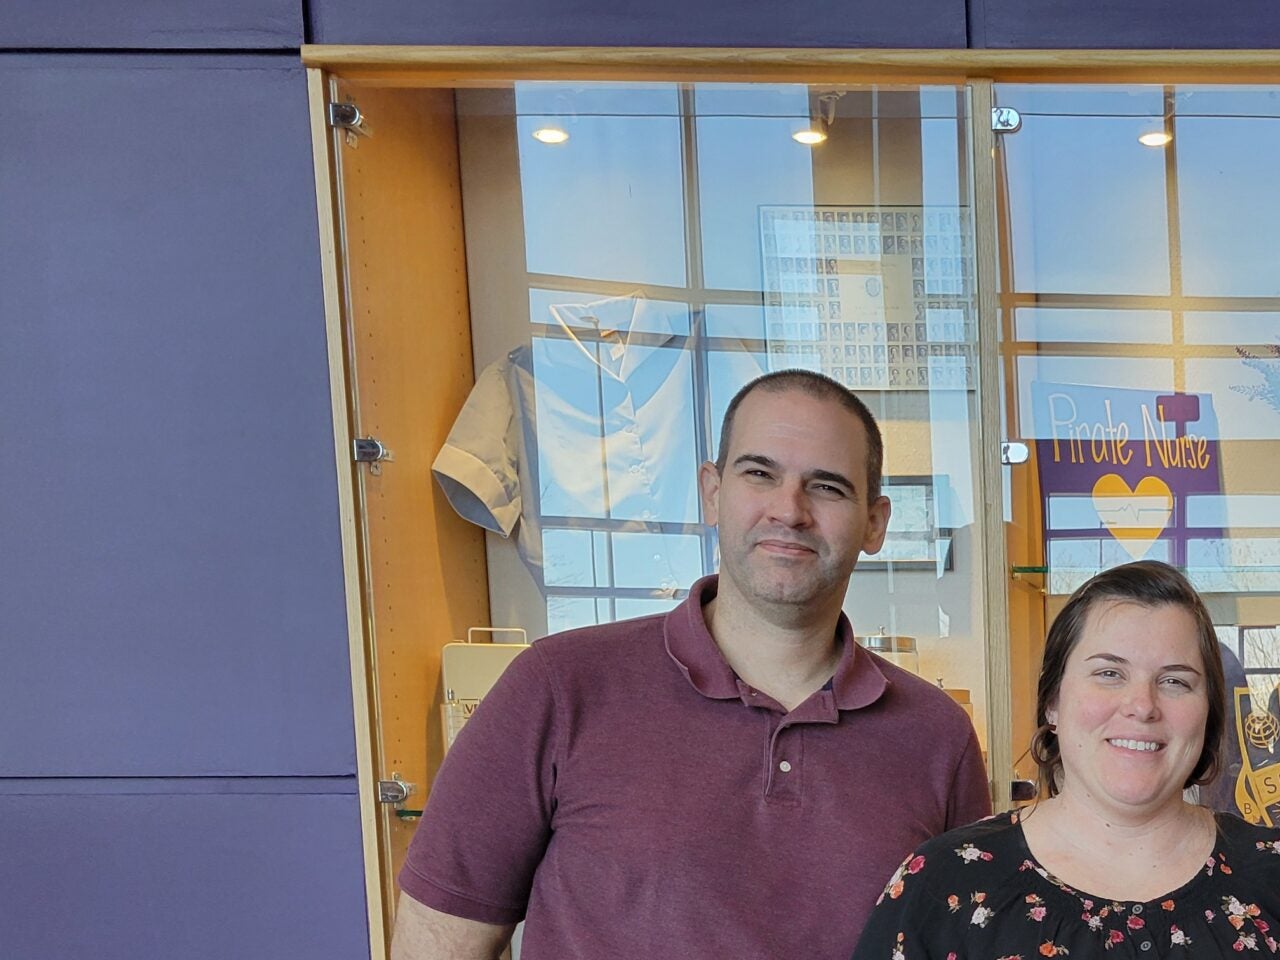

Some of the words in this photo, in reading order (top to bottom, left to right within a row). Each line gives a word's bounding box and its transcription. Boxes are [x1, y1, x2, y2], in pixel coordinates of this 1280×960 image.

[1048, 393, 1133, 465] Pirate
[1141, 404, 1211, 470] Nurse
[1243, 803, 1252, 815] B
